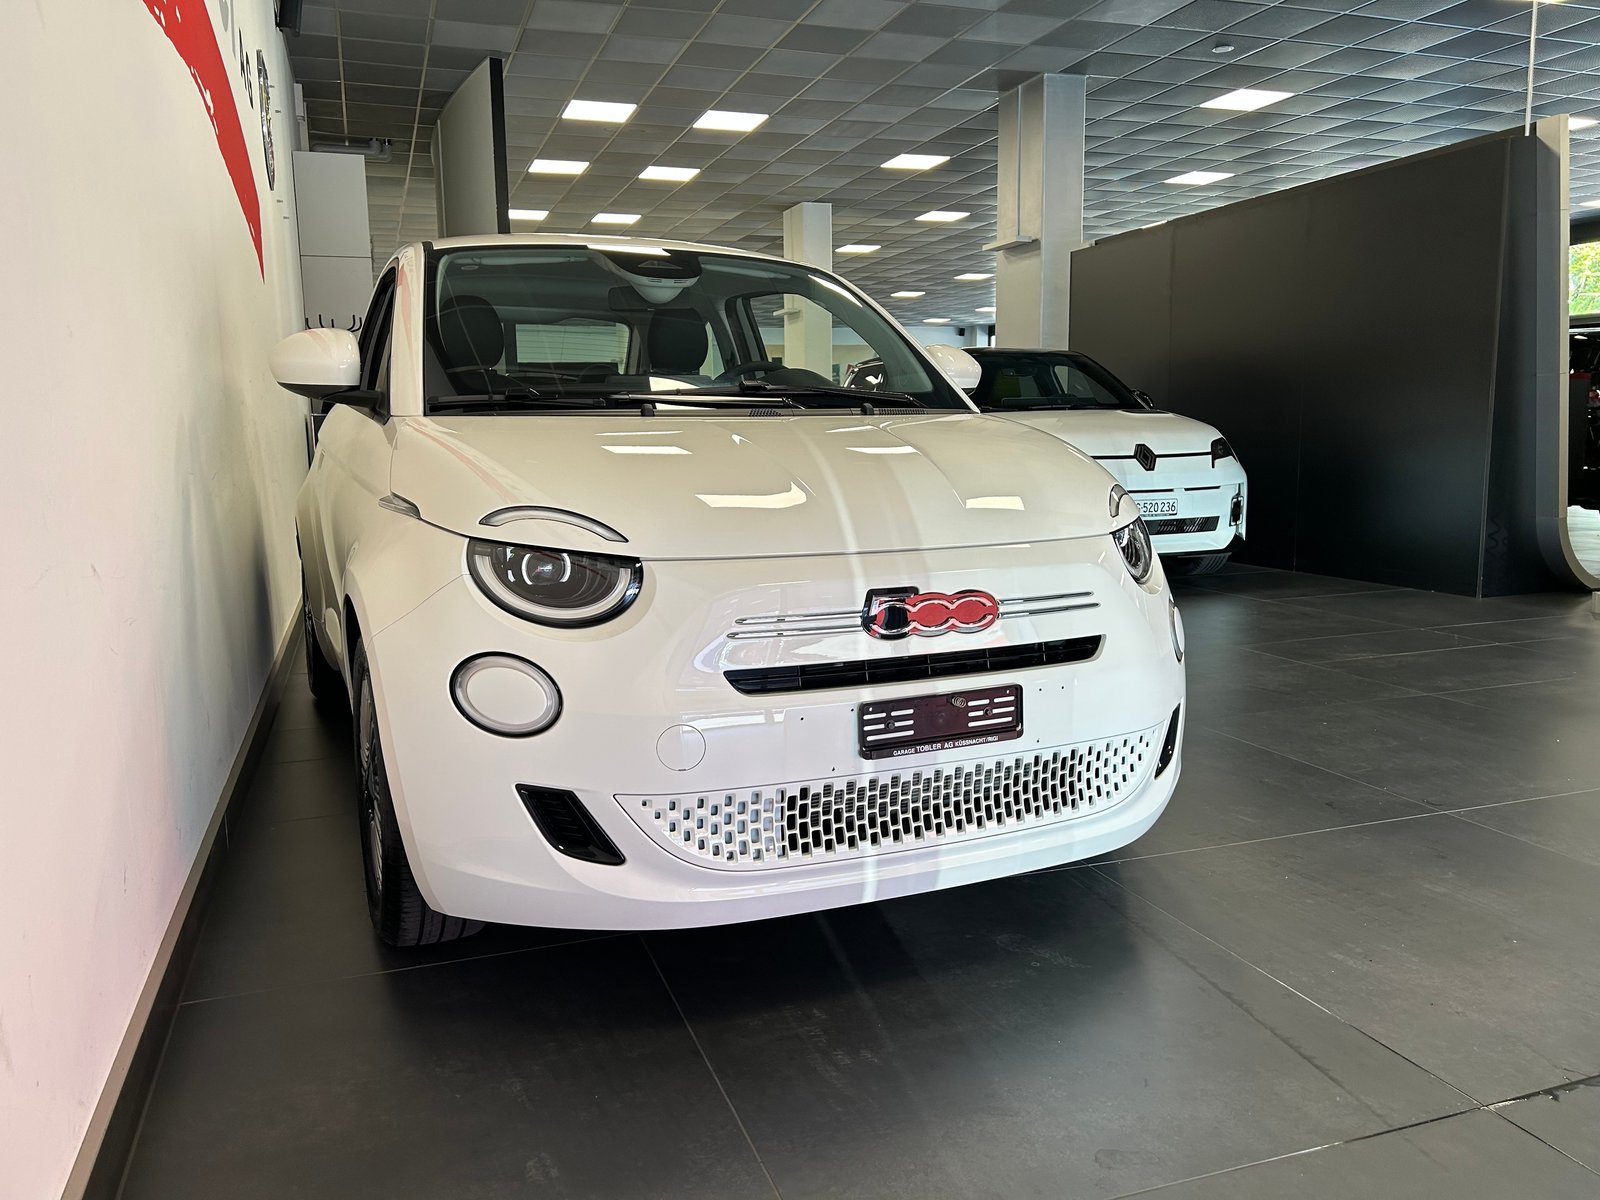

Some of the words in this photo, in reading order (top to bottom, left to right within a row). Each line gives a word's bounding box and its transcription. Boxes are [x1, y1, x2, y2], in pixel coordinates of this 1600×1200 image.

[1160, 501, 1176, 512] 236
[861, 585, 1000, 640] 500
[892, 748, 916, 757] GARAGE
[916, 743, 942, 753] TOBLER
[943, 741, 954, 749] AG
